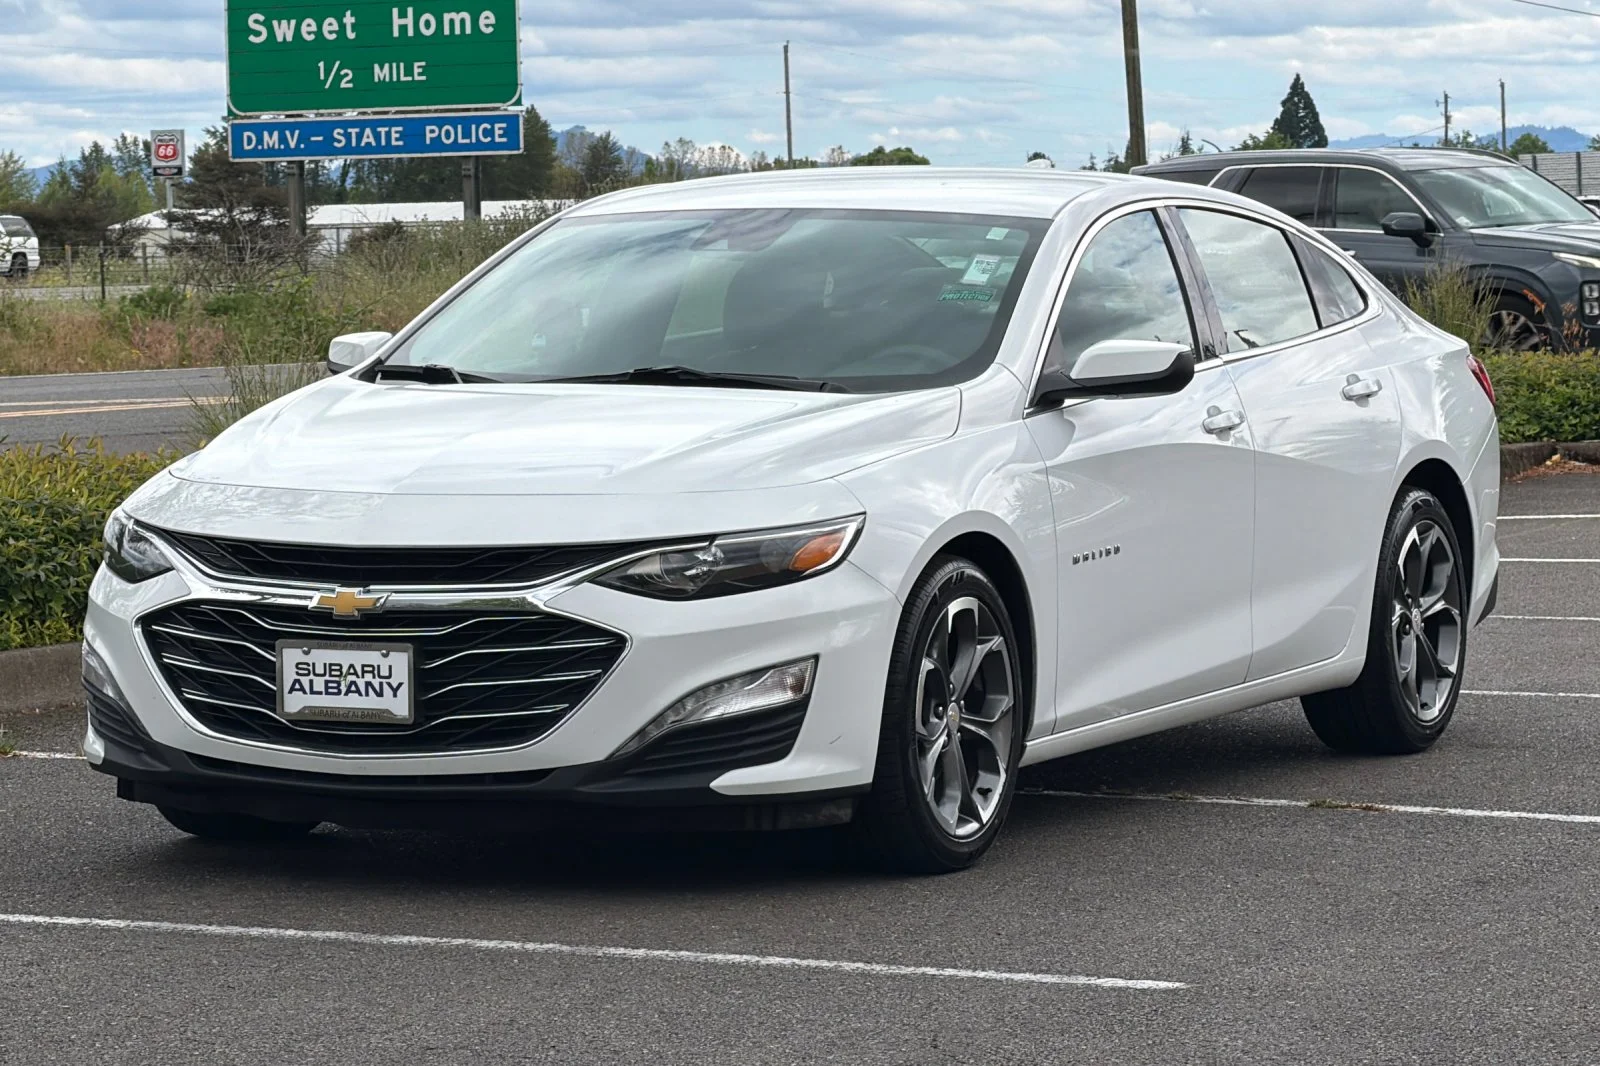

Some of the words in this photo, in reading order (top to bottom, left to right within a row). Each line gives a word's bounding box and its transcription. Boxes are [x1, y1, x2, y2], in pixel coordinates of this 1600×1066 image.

[247, 10, 356, 44] Sweet
[391, 7, 496, 38] Home
[317, 60, 354, 89] 1/2
[373, 61, 427, 83] MILE
[332, 126, 404, 148] STATE
[425, 123, 508, 145] POLICE
[158, 145, 175, 157] 66
[295, 661, 393, 680] SUBARU
[287, 678, 405, 698] ALBANY
